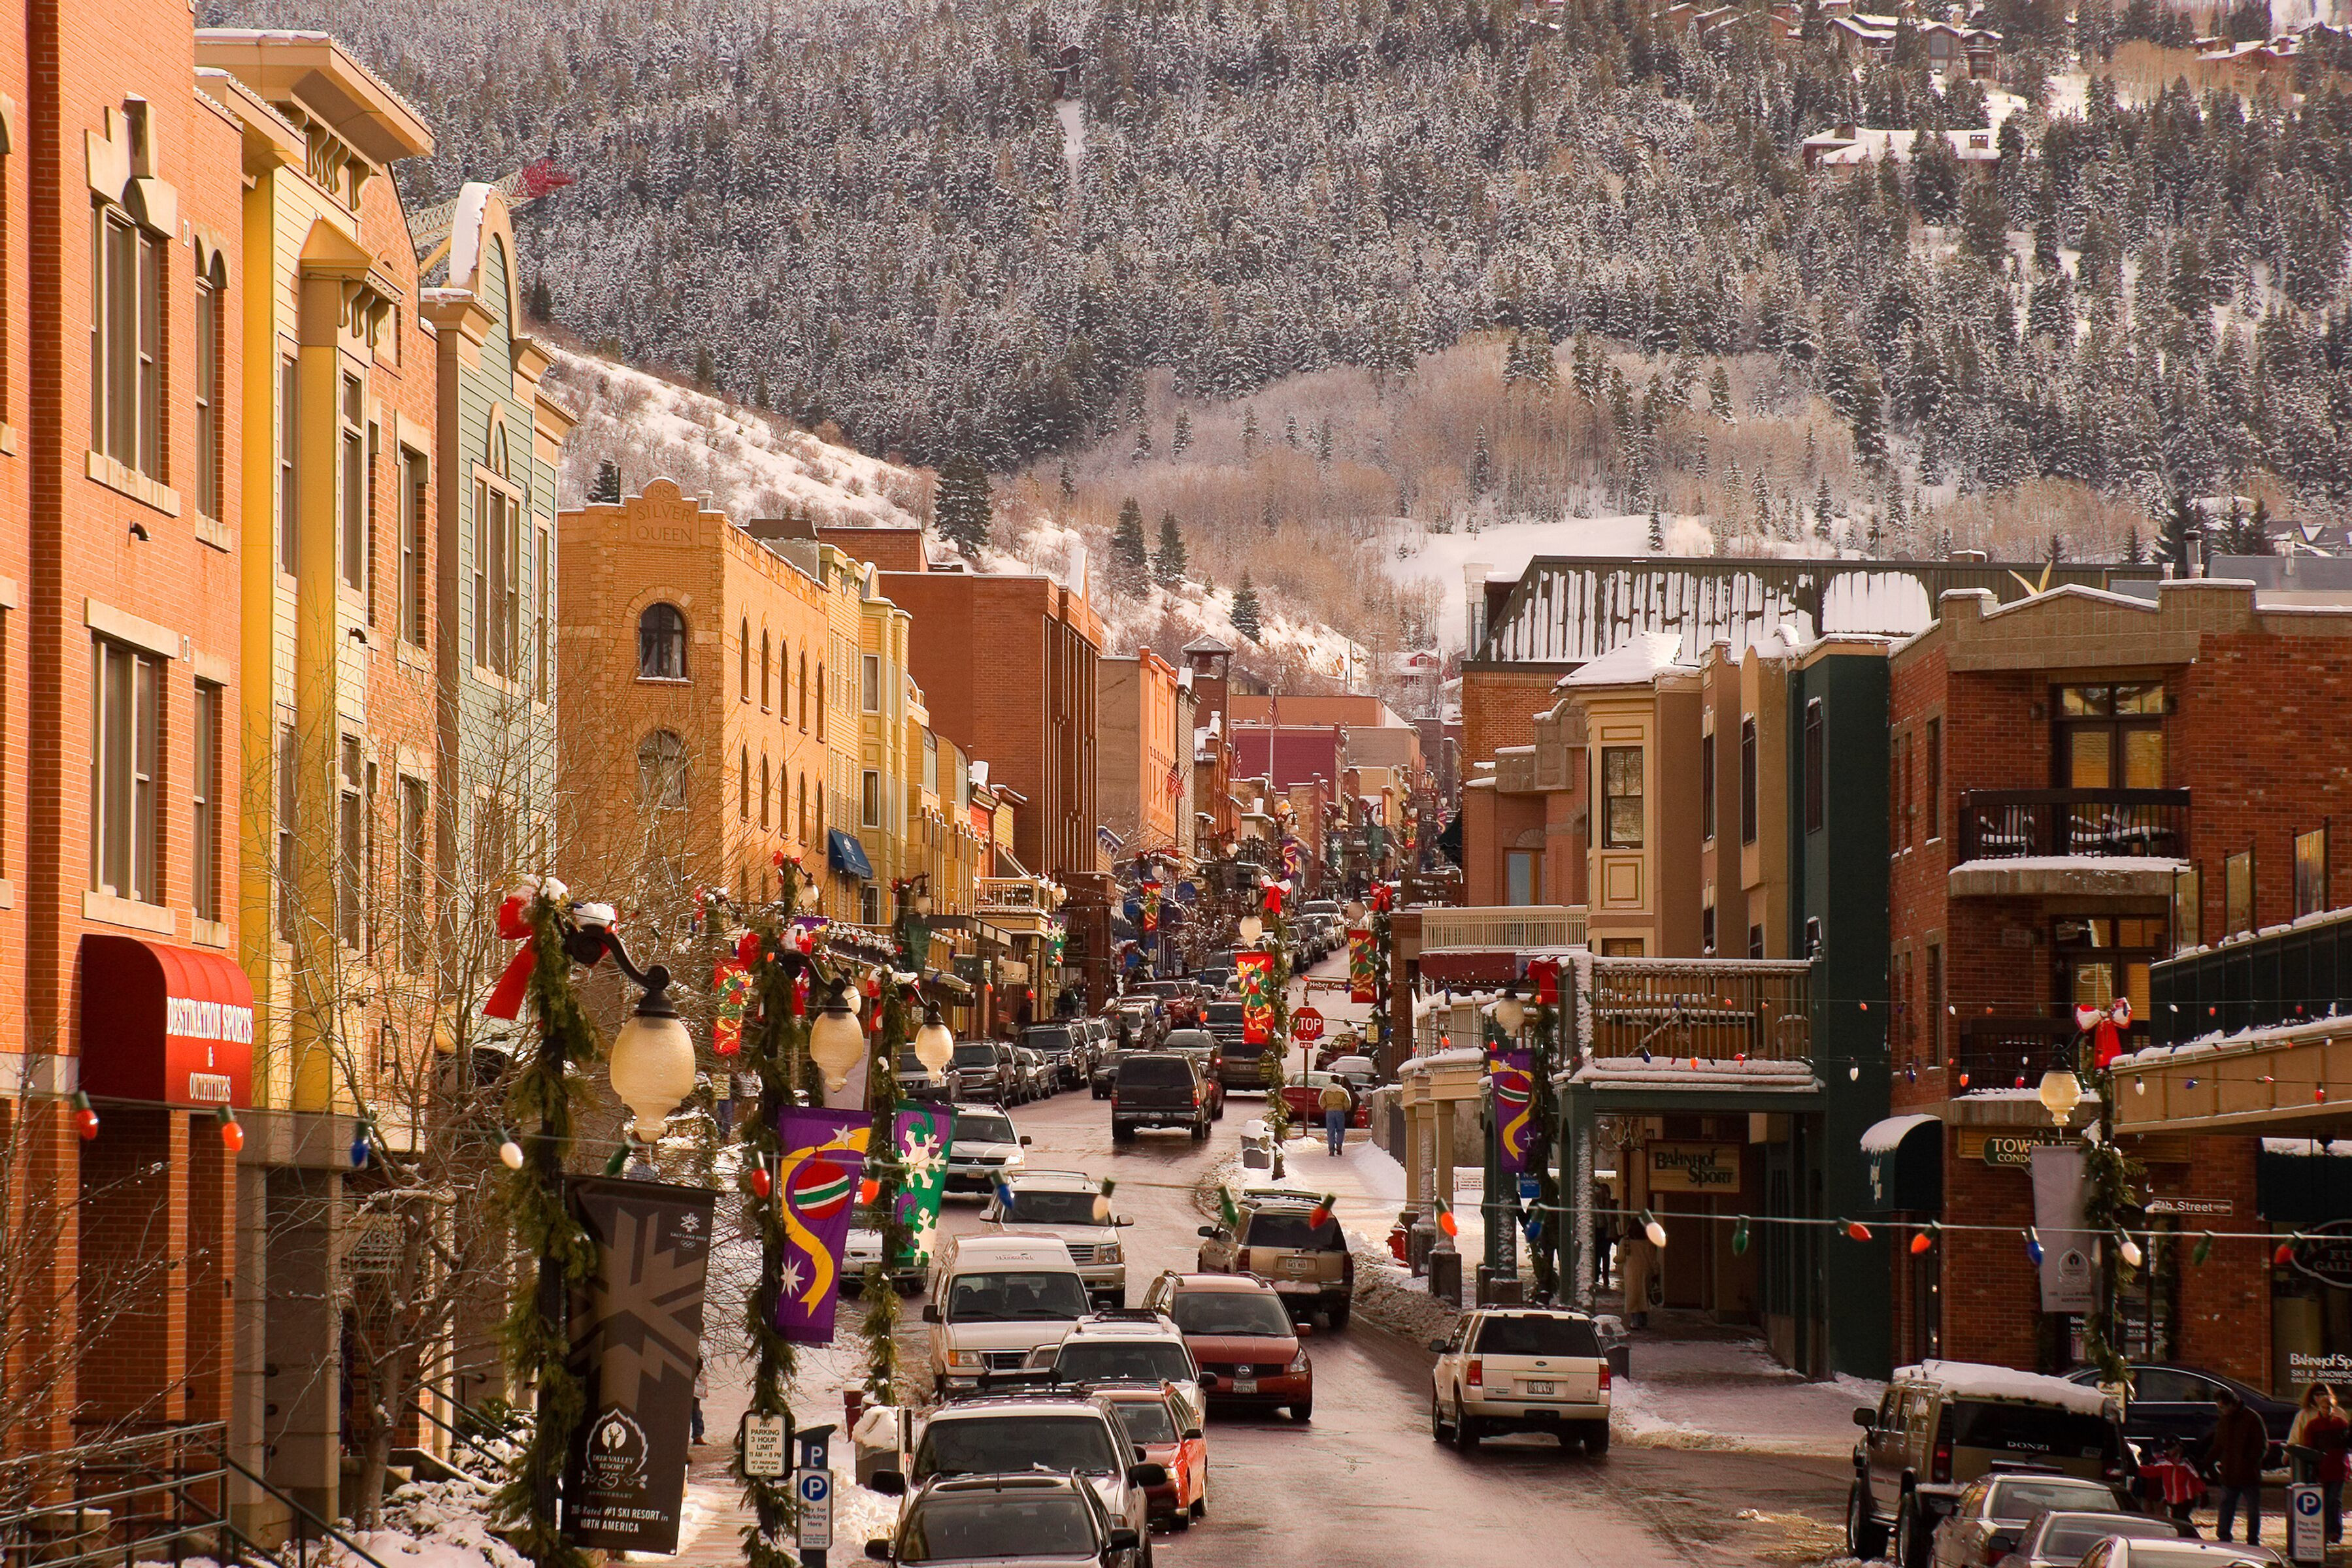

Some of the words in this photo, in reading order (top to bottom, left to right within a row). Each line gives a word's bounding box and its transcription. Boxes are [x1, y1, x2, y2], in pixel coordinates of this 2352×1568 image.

[651, 485, 679, 498] 1982
[637, 504, 691, 523] SILVER
[637, 526, 691, 541] QUEEN
[167, 996, 222, 1039] DESTINATION
[222, 1004, 253, 1045] SPORTS
[208, 1046, 214, 1067] &
[190, 1072, 231, 1102] OUTFITTERS
[2177, 1201, 2213, 1212] Street
[2007, 1441, 2050, 1451] DONZI
[608, 1456, 635, 1464] VALLEY
[588, 1490, 633, 1499] ANNIVERSARY
[808, 1479, 823, 1498] P
[2303, 1495, 2317, 1513] P
[604, 1506, 616, 1516] #1
[618, 1507, 630, 1517] SKI
[631, 1509, 660, 1520] RESORT
[602, 1520, 639, 1533] AMERICA
